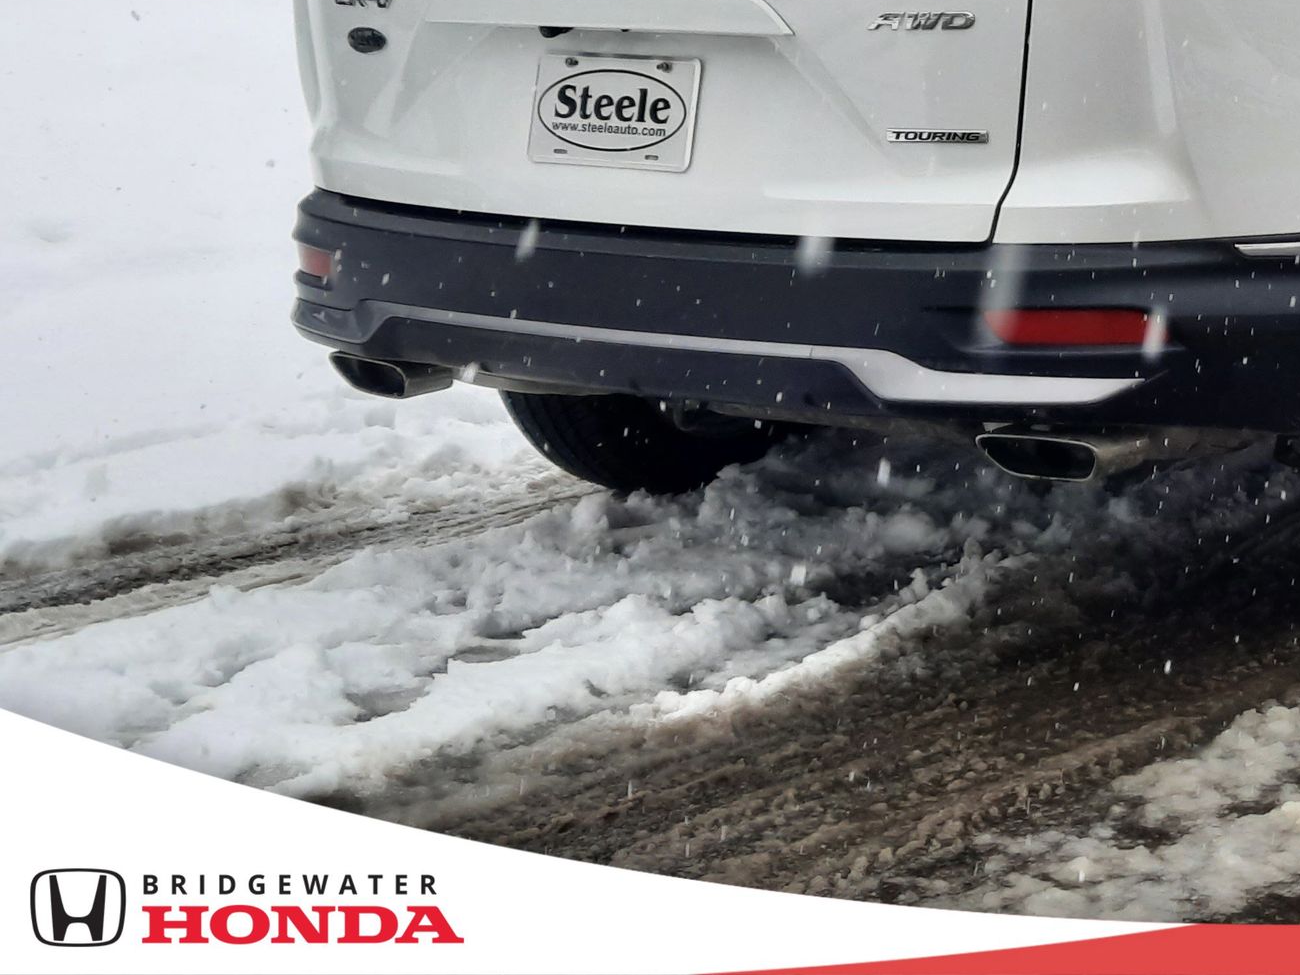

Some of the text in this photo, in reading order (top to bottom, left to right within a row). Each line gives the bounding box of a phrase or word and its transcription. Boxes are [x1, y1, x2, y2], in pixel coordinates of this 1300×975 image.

[867, 11, 976, 31] AWD
[554, 84, 671, 124] Steele
[552, 122, 666, 137] www.steeleauto.com
[891, 130, 981, 142] TOURING
